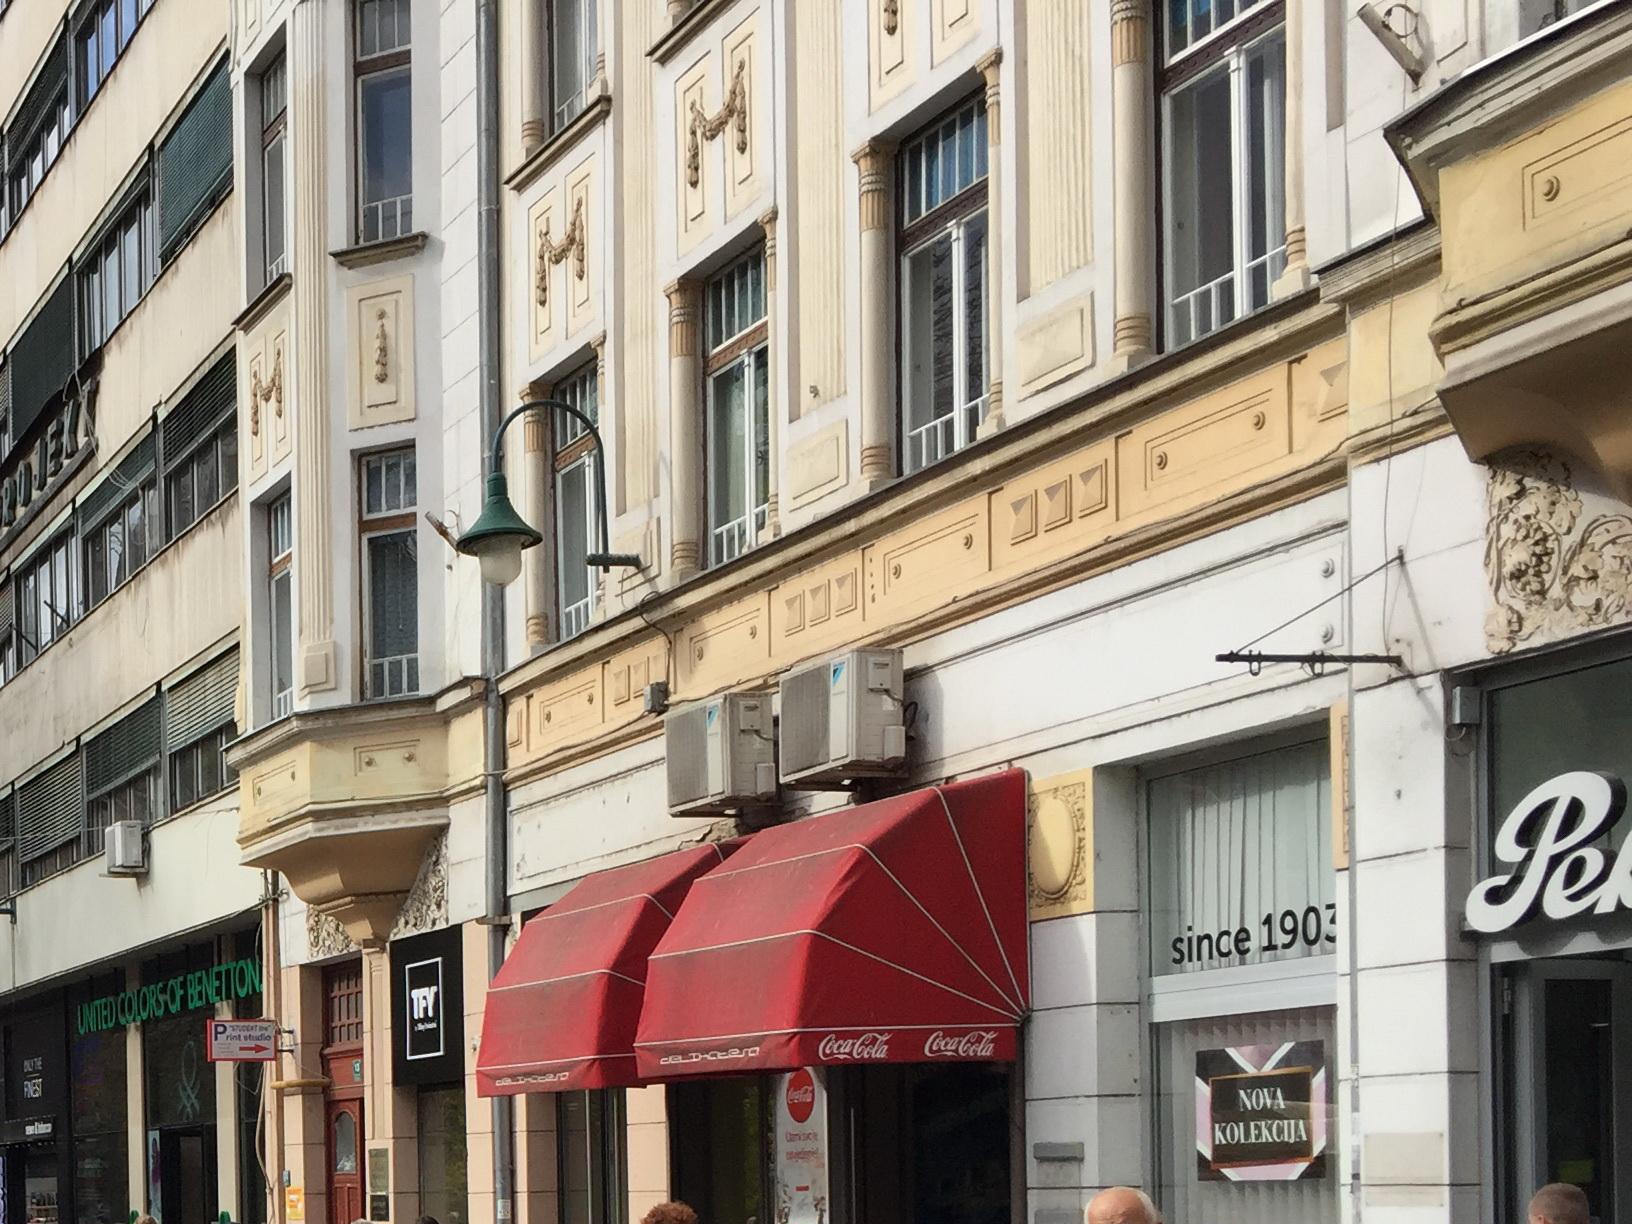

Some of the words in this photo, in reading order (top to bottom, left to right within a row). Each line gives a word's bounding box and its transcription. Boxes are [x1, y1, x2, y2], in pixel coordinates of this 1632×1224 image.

[1171, 926, 1251, 964] since
[78, 997, 116, 1035] UNITED
[118, 982, 165, 1025] COLORS
[167, 976, 185, 1013] OF
[411, 985, 438, 1020] TFY
[819, 1033, 893, 1061] Coca-Cola
[924, 1030, 999, 1057] Coca-Cola
[1239, 1088, 1285, 1112] NOVA
[1215, 1119, 1307, 1145] KOLEKCIJA
